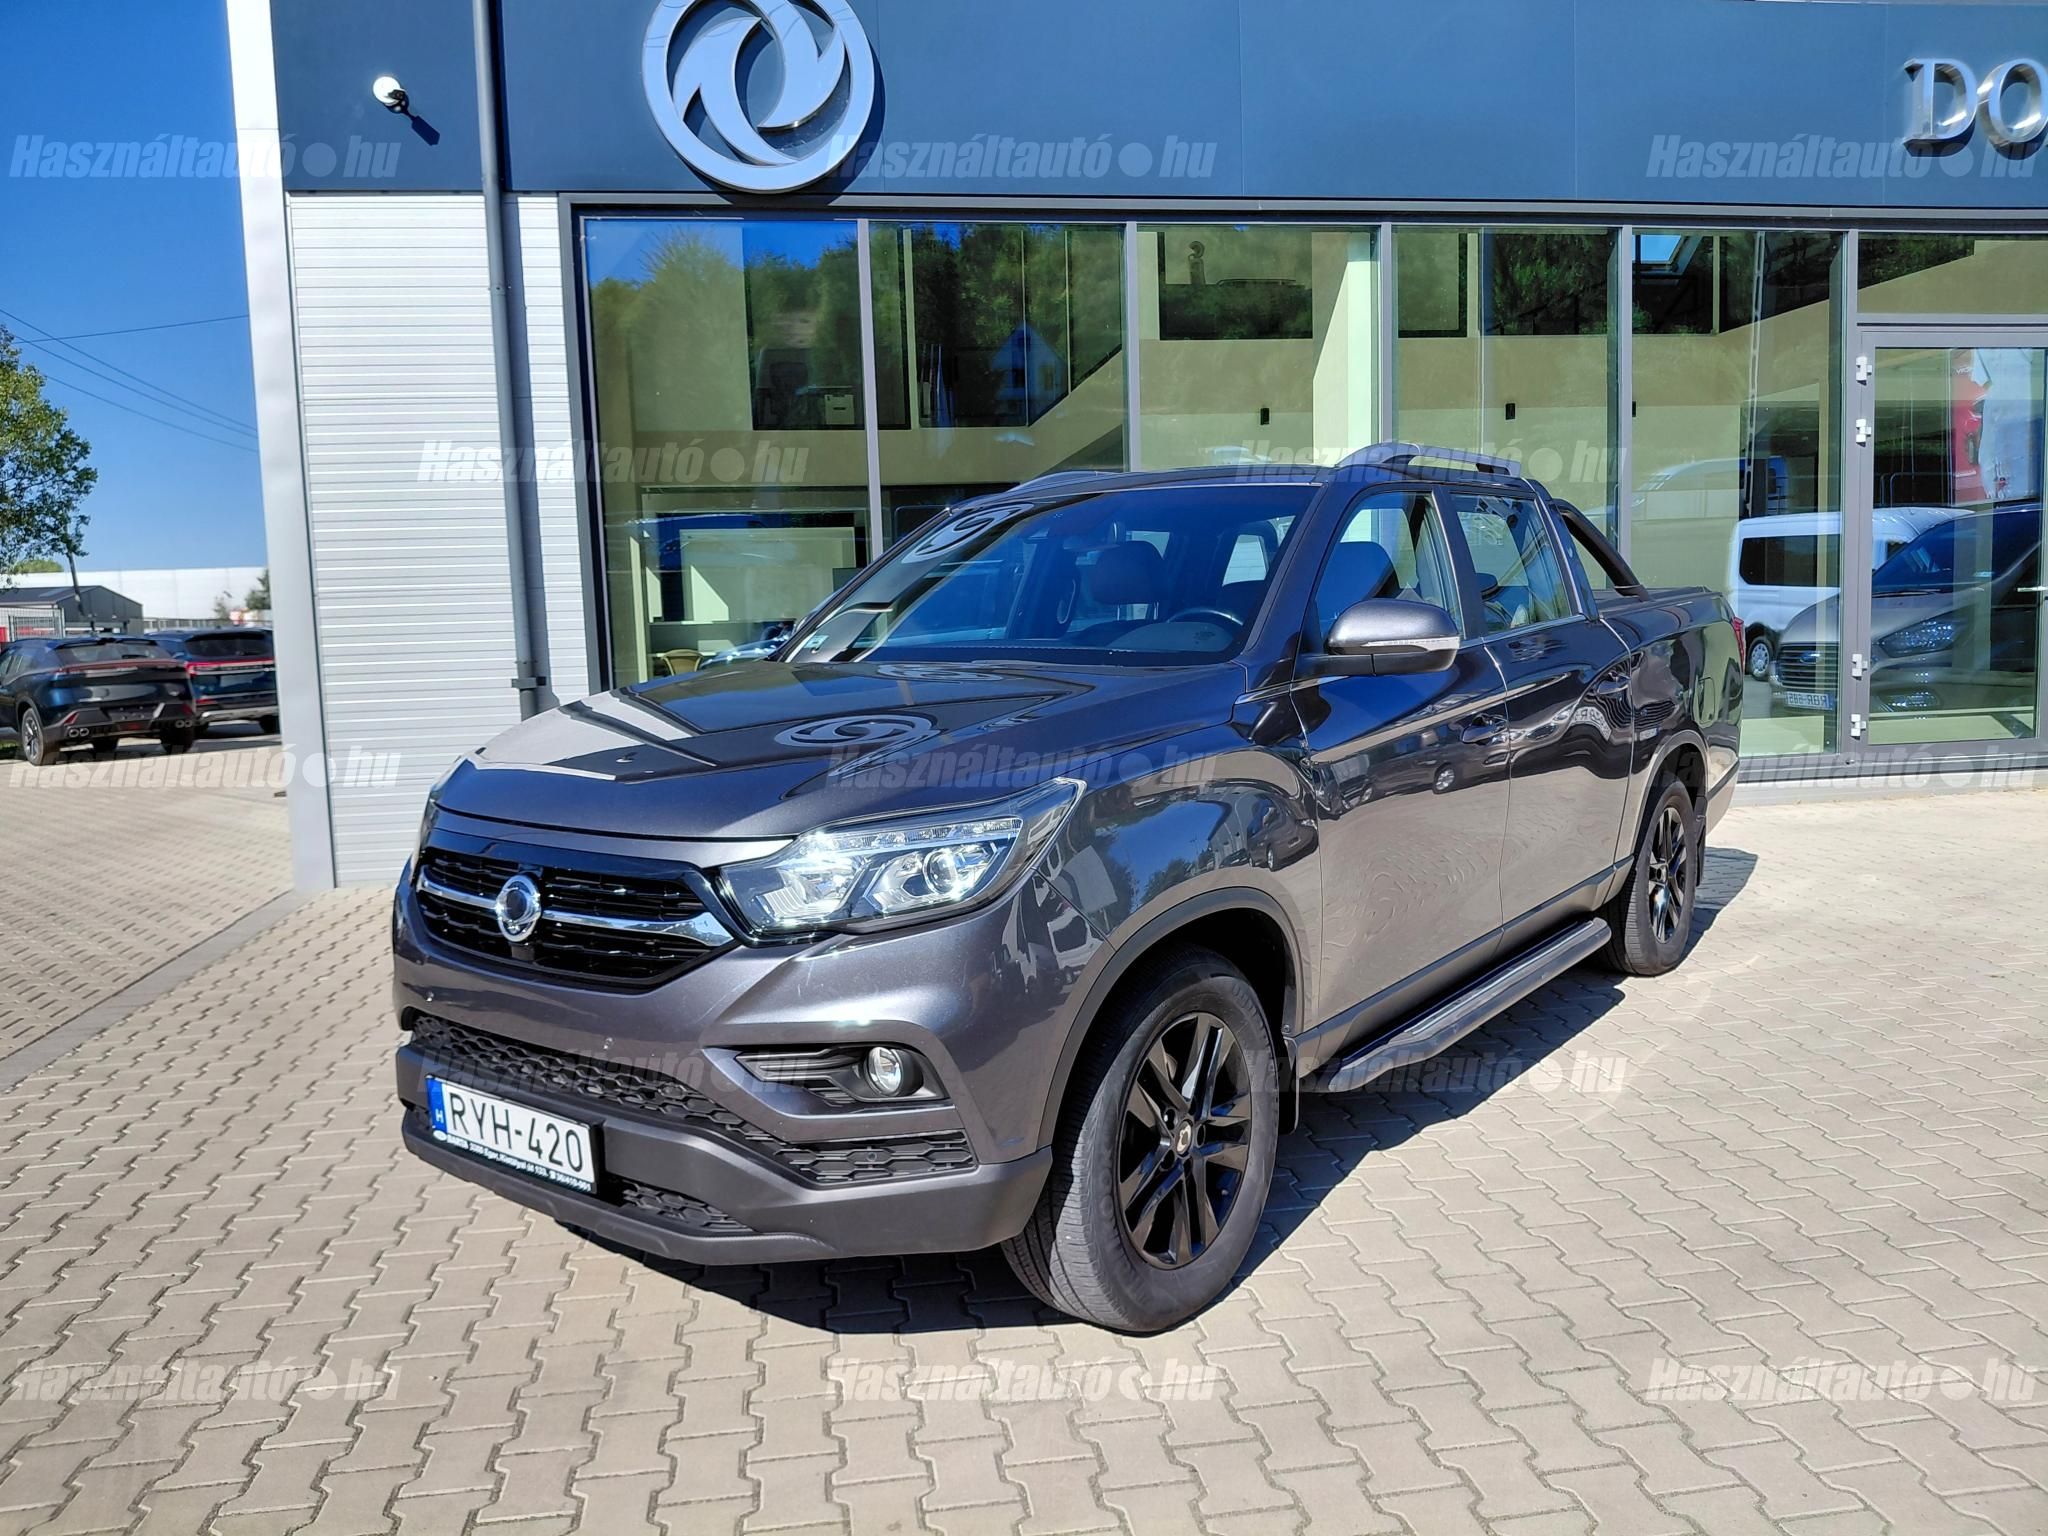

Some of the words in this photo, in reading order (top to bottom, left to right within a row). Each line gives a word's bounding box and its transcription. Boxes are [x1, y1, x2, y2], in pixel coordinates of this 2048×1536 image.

[1902, 57, 2048, 157] DO
[436, 1109, 445, 1123] H
[450, 1093, 583, 1172] RYH-420
